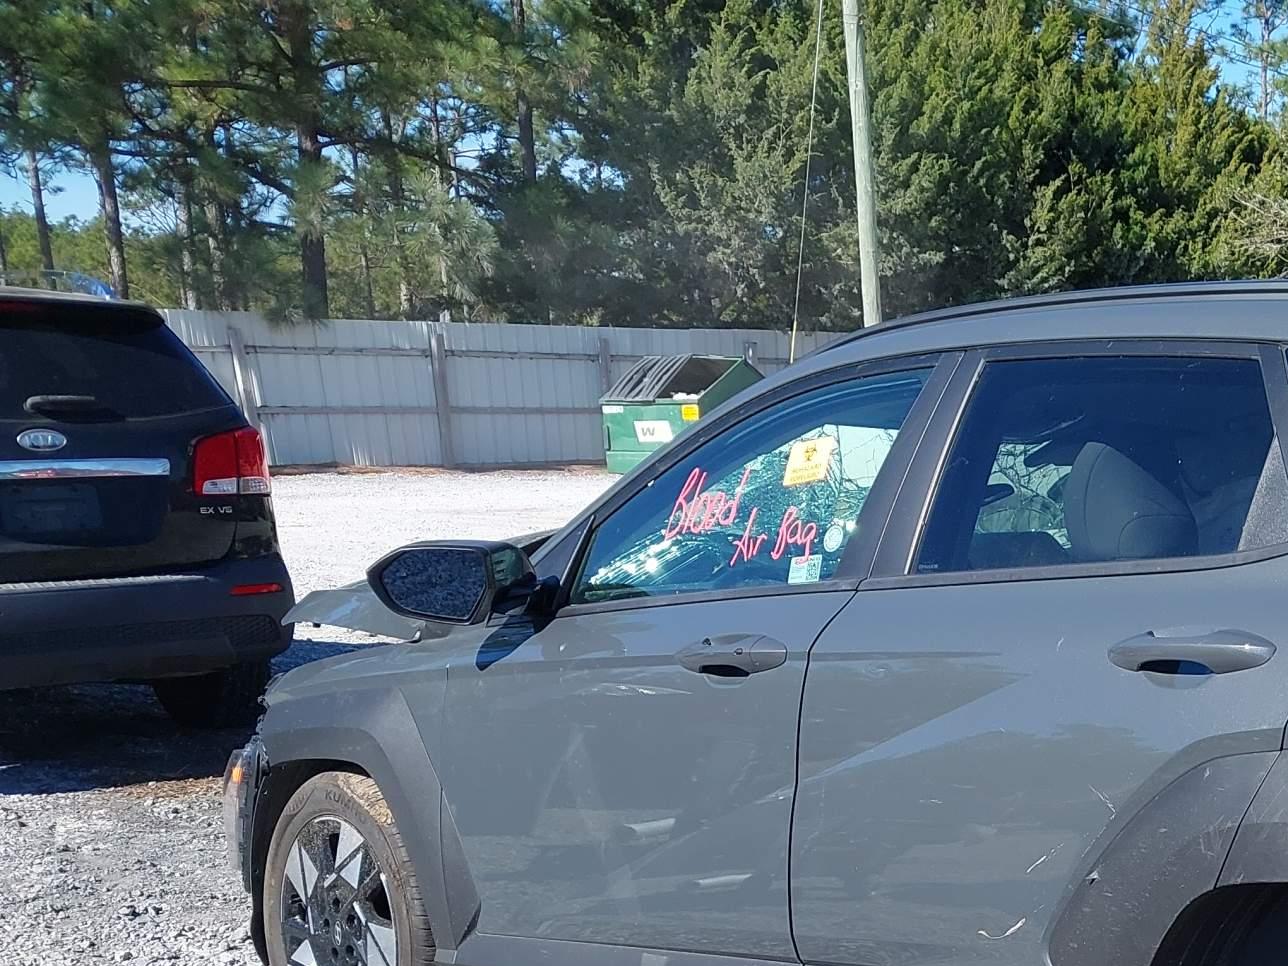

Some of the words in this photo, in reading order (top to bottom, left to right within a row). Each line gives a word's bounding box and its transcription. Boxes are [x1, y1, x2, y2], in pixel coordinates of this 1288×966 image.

[200, 506, 215, 514] EX
[664, 467, 751, 542] Blood
[729, 507, 768, 567] Air
[770, 505, 817, 565] Bag
